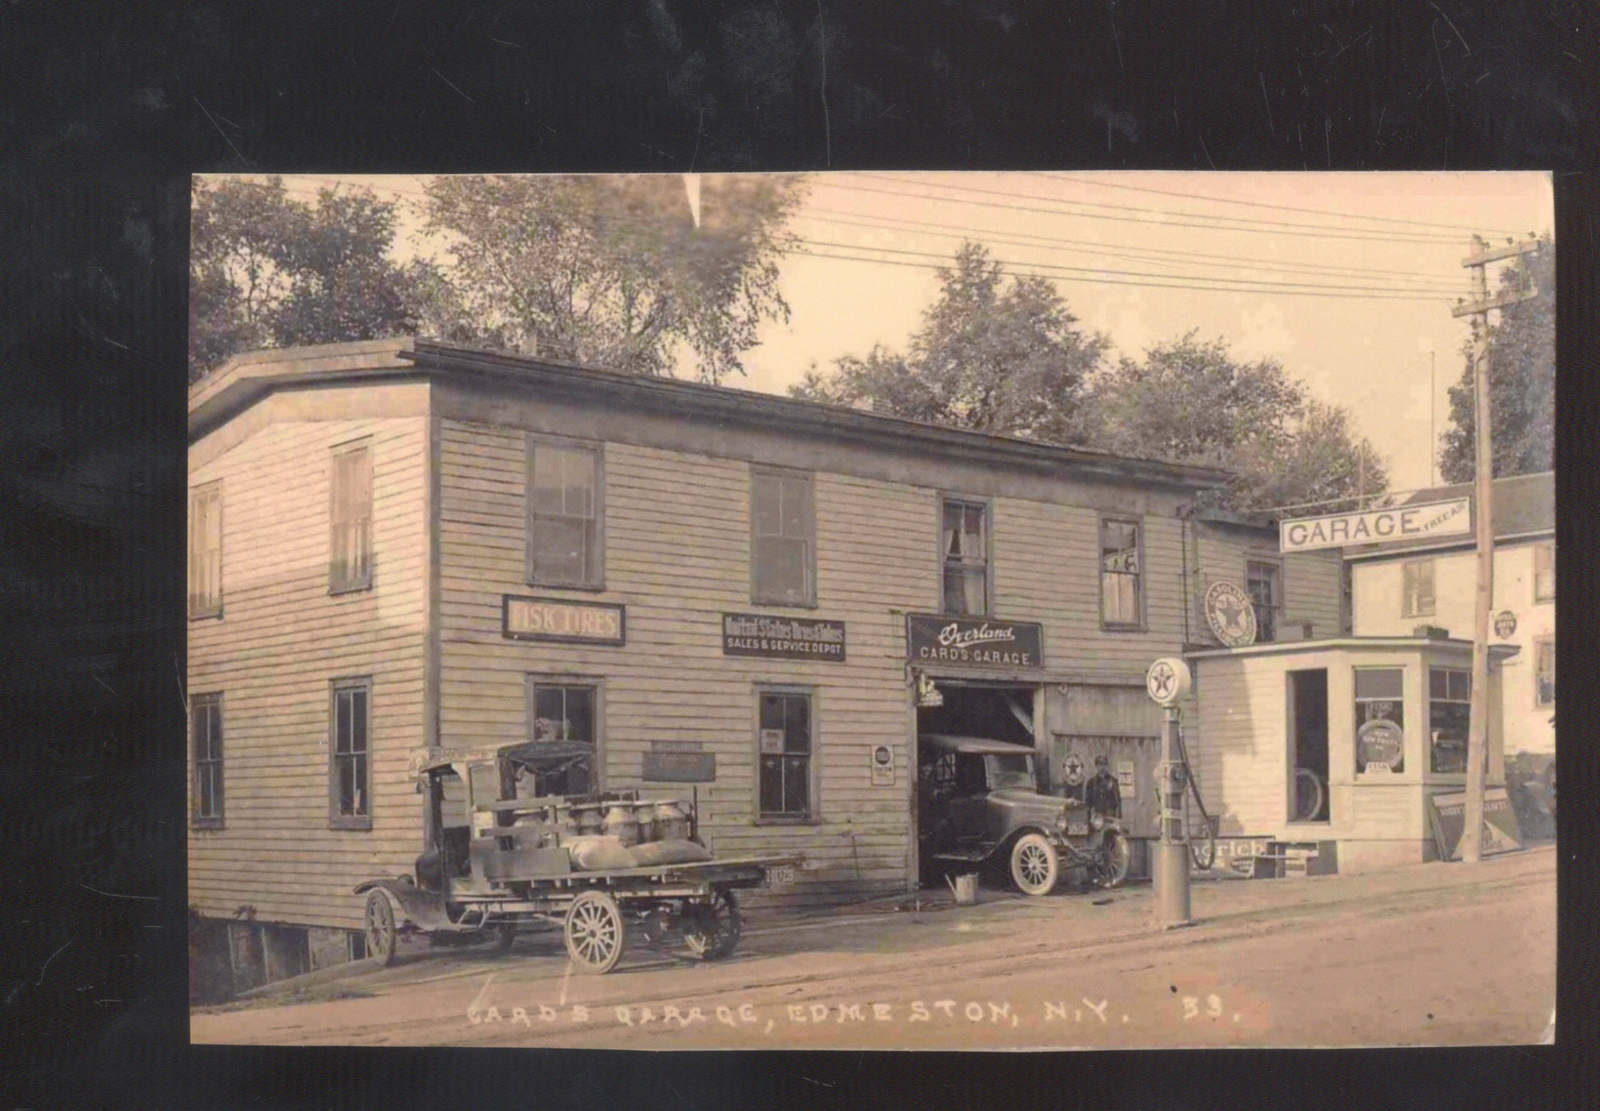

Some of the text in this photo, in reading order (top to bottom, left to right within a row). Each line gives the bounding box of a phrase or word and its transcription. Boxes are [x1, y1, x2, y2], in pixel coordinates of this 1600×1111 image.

[1288, 509, 1421, 546] GARAGE
[512, 602, 618, 635] FISK TIRES
[727, 638, 841, 654] SALES & SERVICE DEPOT
[937, 622, 1016, 648] Overland
